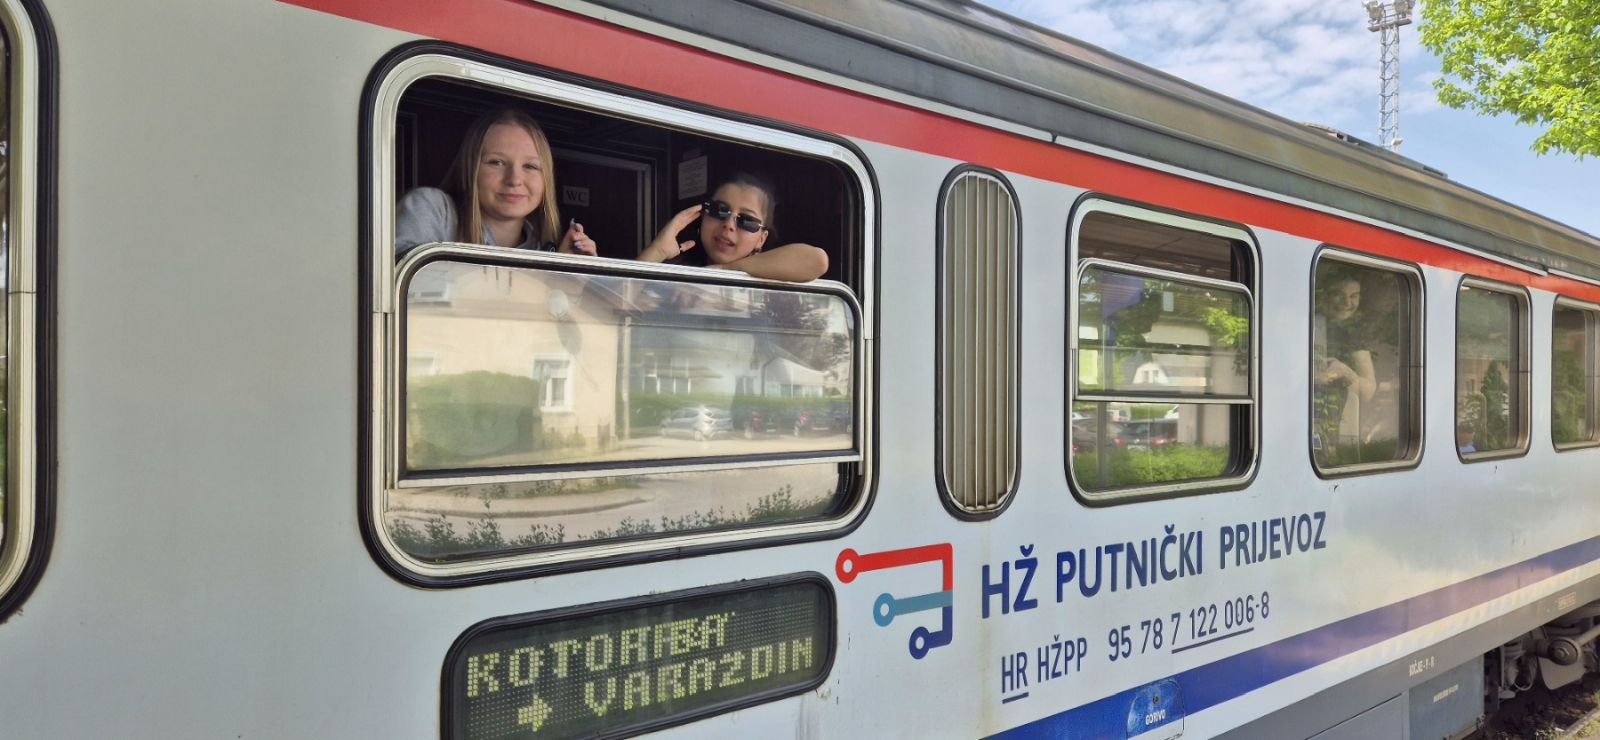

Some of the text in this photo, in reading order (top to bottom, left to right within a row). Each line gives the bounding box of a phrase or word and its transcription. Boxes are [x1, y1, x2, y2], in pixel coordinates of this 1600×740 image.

[566, 190, 587, 203] WC
[981, 511, 1327, 619] HŽ PUTNIČKI PRIJEVOZ
[1001, 591, 1270, 693] HR HŽPP 95 78 7 122 006-8
[1145, 709, 1166, 725] GORIVO
